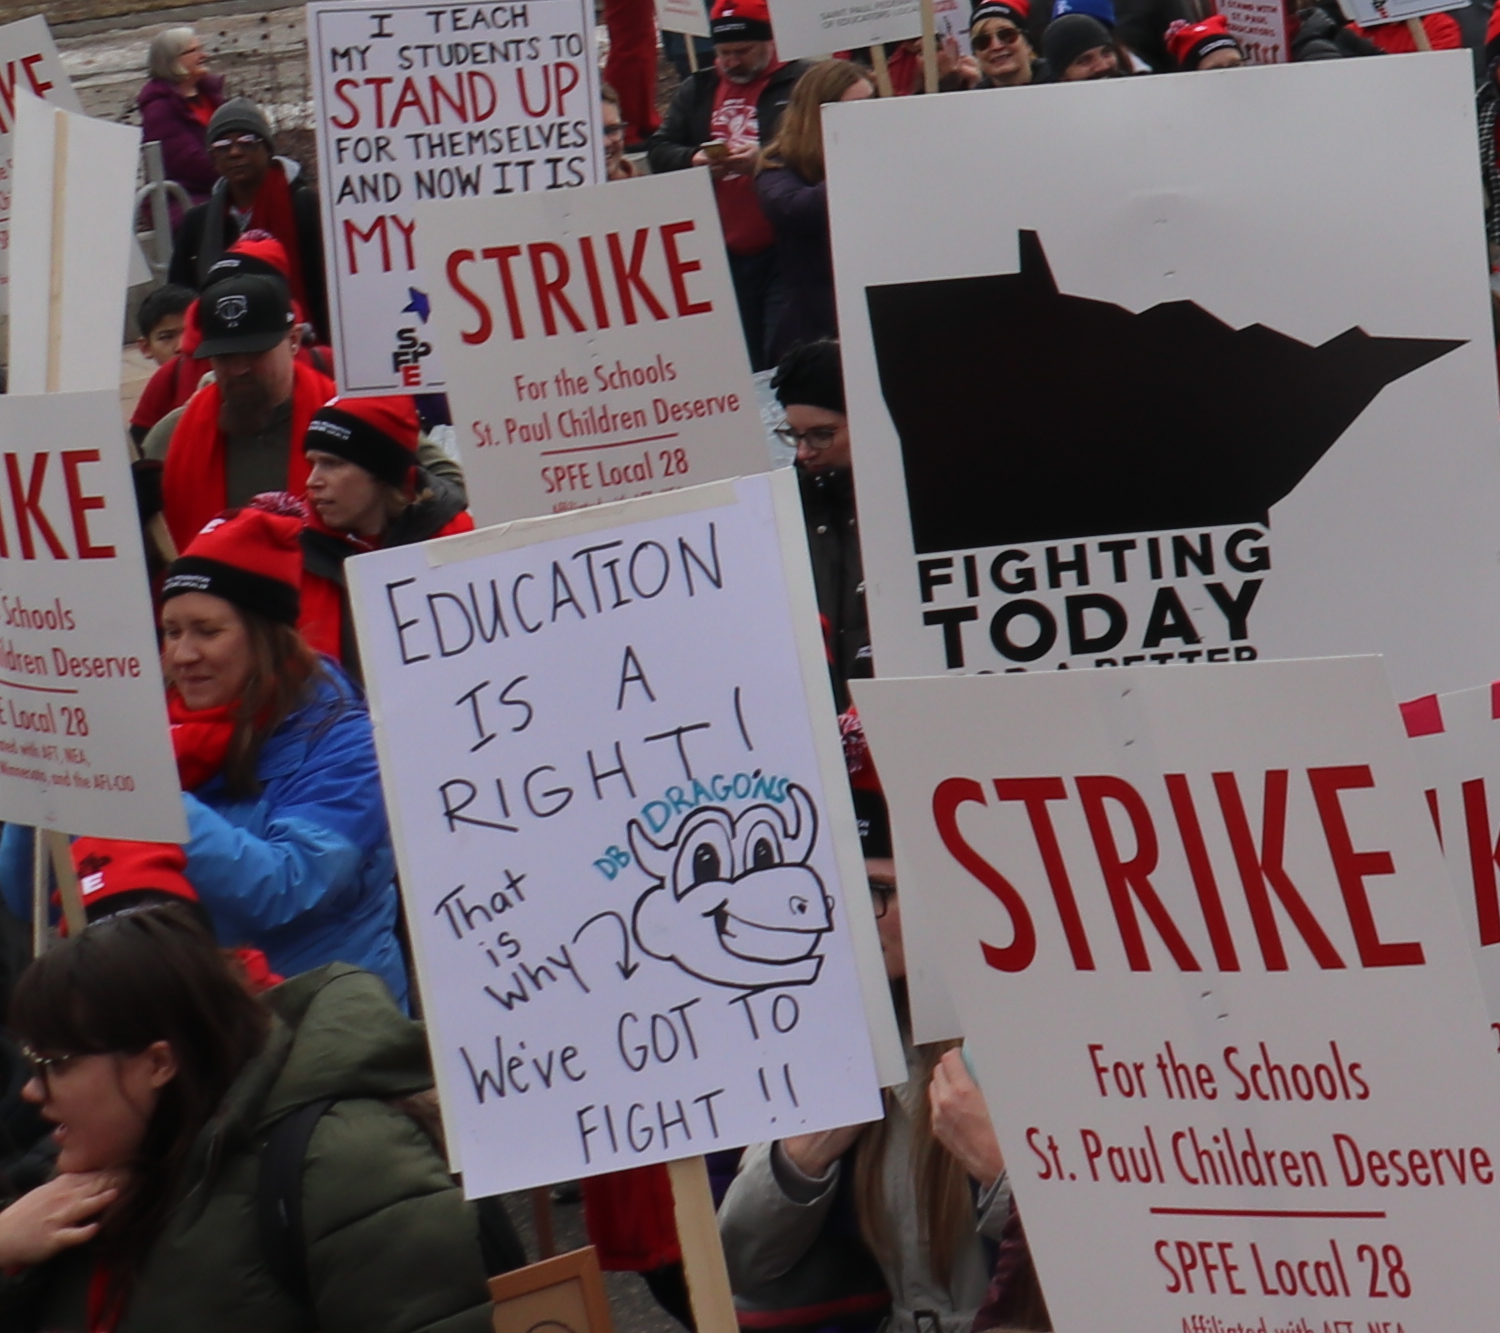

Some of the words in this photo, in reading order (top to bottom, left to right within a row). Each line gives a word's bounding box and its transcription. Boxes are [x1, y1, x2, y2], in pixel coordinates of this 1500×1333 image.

[331, 45, 371, 72] MY
[398, 37, 540, 71] STUDENTS
[550, 31, 586, 57] TO
[370, 14, 393, 38] I
[426, 5, 528, 33] TEACH
[330, 71, 496, 130] STAND
[516, 62, 579, 118] UP
[336, 136, 395, 164] FOR
[405, 121, 587, 159] THEMSELVES
[336, 172, 401, 204] AND
[415, 165, 481, 199] NOW
[493, 160, 534, 194] IT
[545, 156, 585, 190] IS
[343, 215, 415, 274] MY
[446, 220, 713, 345] STRIKE
[386, 523, 722, 665] EDUCATION
[918, 529, 1270, 616] FIGHTING
[923, 579, 1263, 670] TODAY
[456, 676, 533, 752] IS
[617, 646, 656, 710] A
[641, 768, 789, 836] DRAGONS
[434, 868, 529, 944] That
[595, 841, 630, 881] DB
[932, 765, 1425, 972] STRIKE
[479, 931, 522, 964] is
[617, 995, 702, 1074] GOT
[728, 987, 798, 1036] TO
[1088, 1044, 1147, 1098] For
[1157, 1041, 1217, 1100] the
[1223, 1041, 1369, 1101] Schools
[577, 1089, 725, 1164] FIGHT
